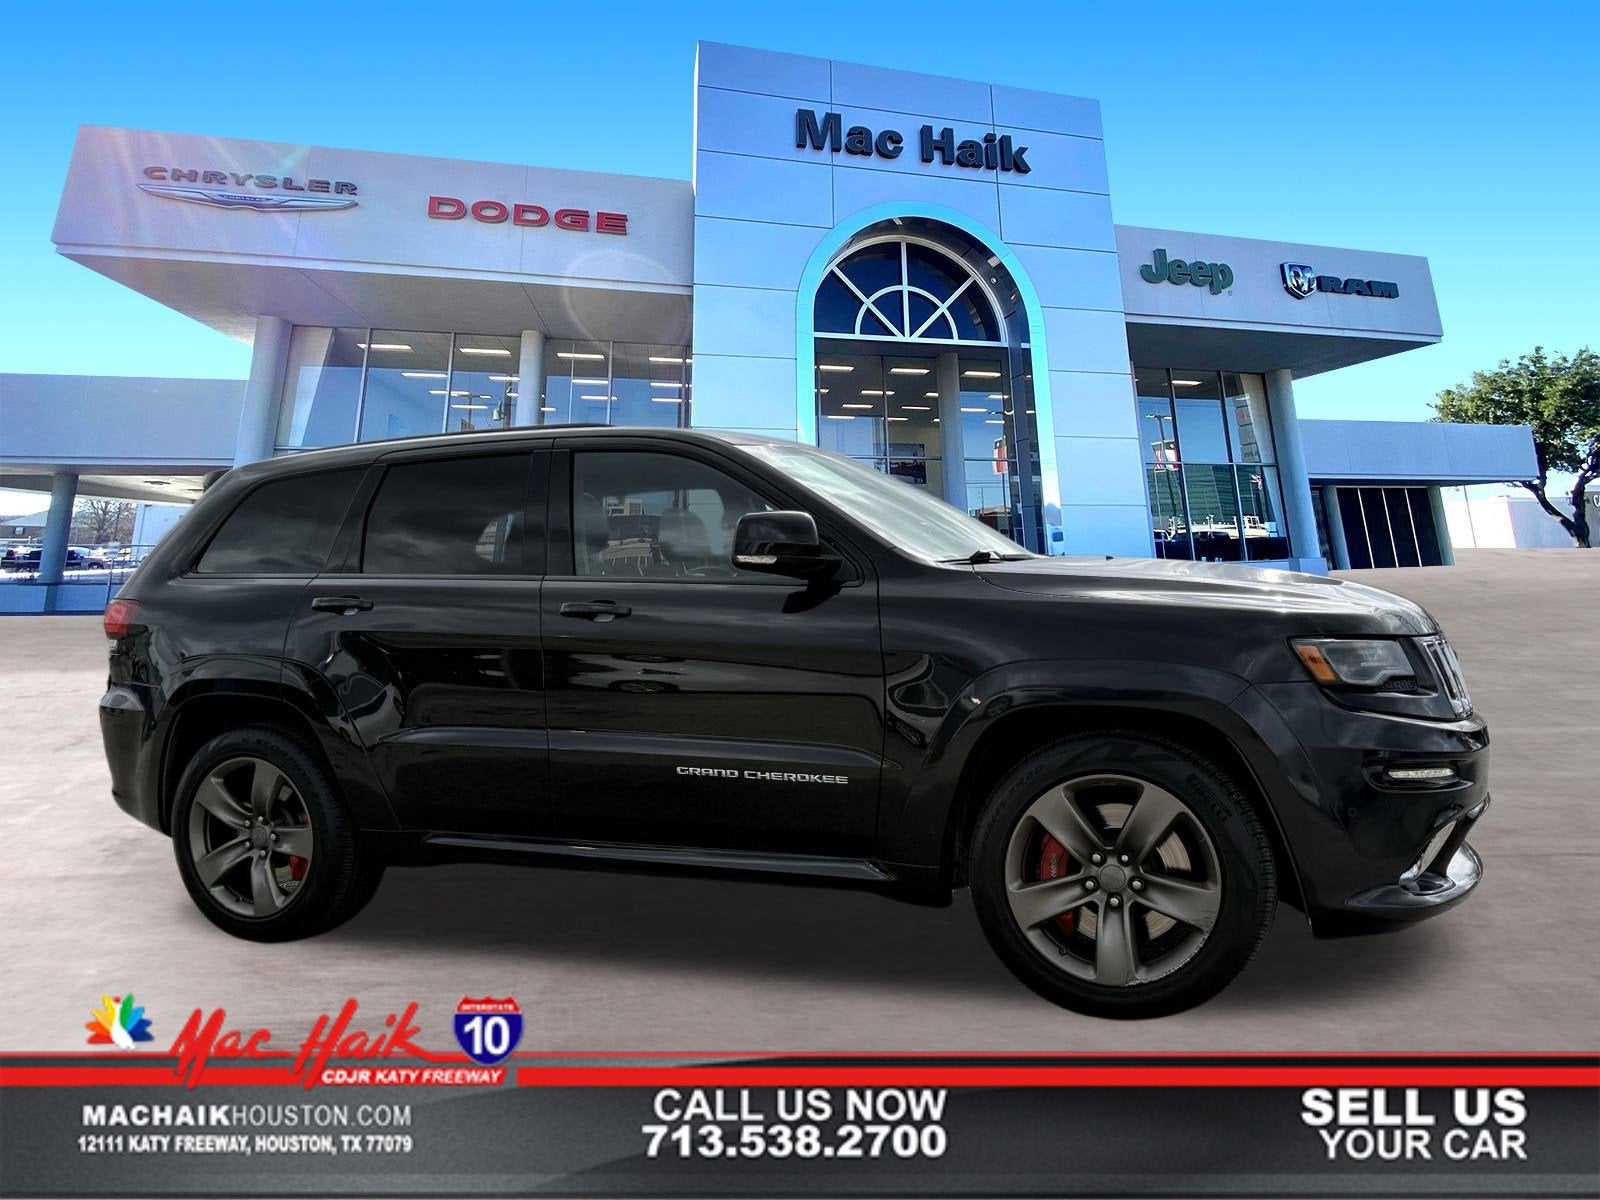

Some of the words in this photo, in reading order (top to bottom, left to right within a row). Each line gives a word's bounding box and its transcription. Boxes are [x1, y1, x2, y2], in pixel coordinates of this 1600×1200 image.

[795, 108, 904, 159] Mac
[920, 124, 1032, 174] Haik
[143, 166, 358, 196] CHRYSLER
[428, 195, 628, 236] DODGE
[1140, 248, 1234, 295] Jeep
[1315, 275, 1399, 298] RAM
[676, 766, 739, 778] GRAND
[743, 770, 849, 784] CHEROKEE
